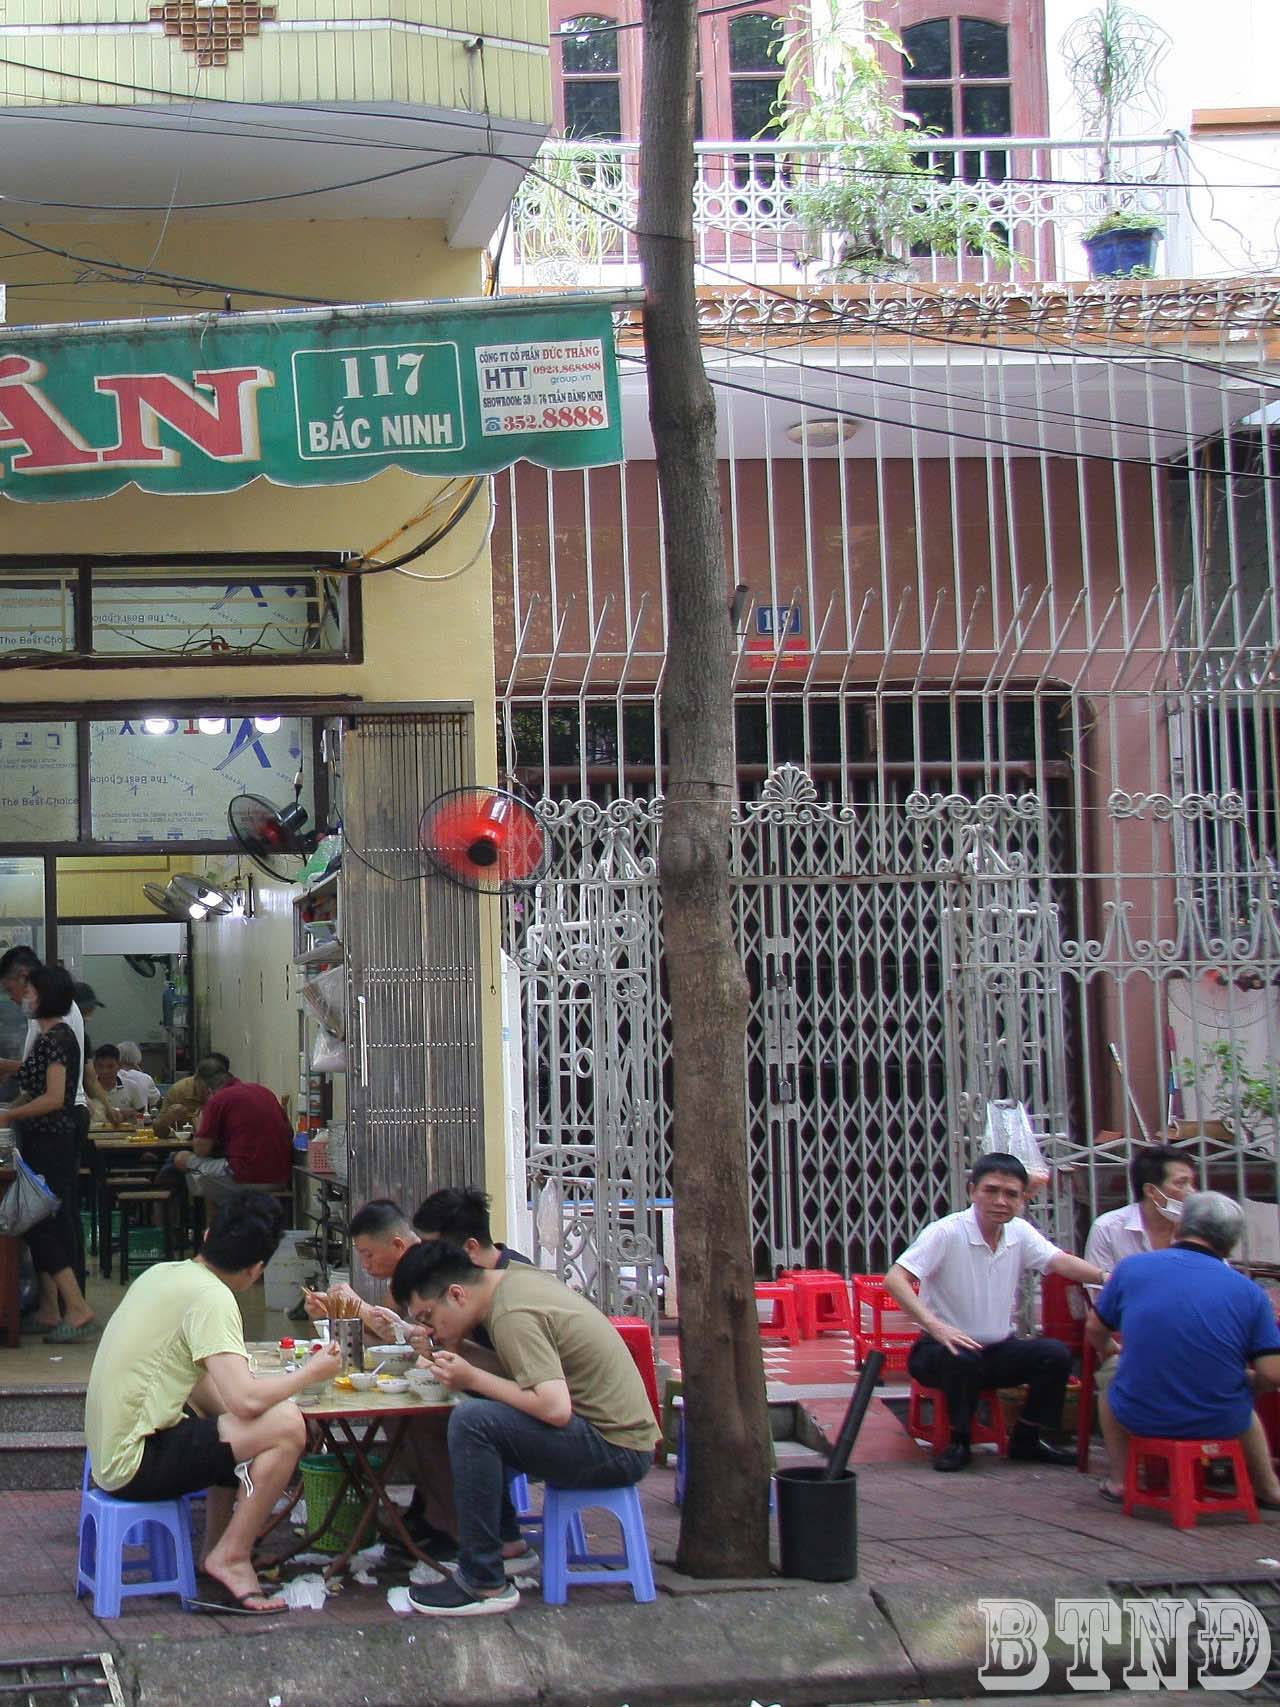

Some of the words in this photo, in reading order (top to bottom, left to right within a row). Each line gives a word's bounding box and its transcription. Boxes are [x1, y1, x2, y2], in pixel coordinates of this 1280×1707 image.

[500, 352, 509, 362] TY
[542, 346, 563, 360] ĐỨC
[340, 353, 425, 399] 117
[485, 367, 528, 390] HTT
[308, 406, 371, 452] BẮC
[382, 414, 453, 447] NINH
[504, 405, 604, 431] 352.8888
